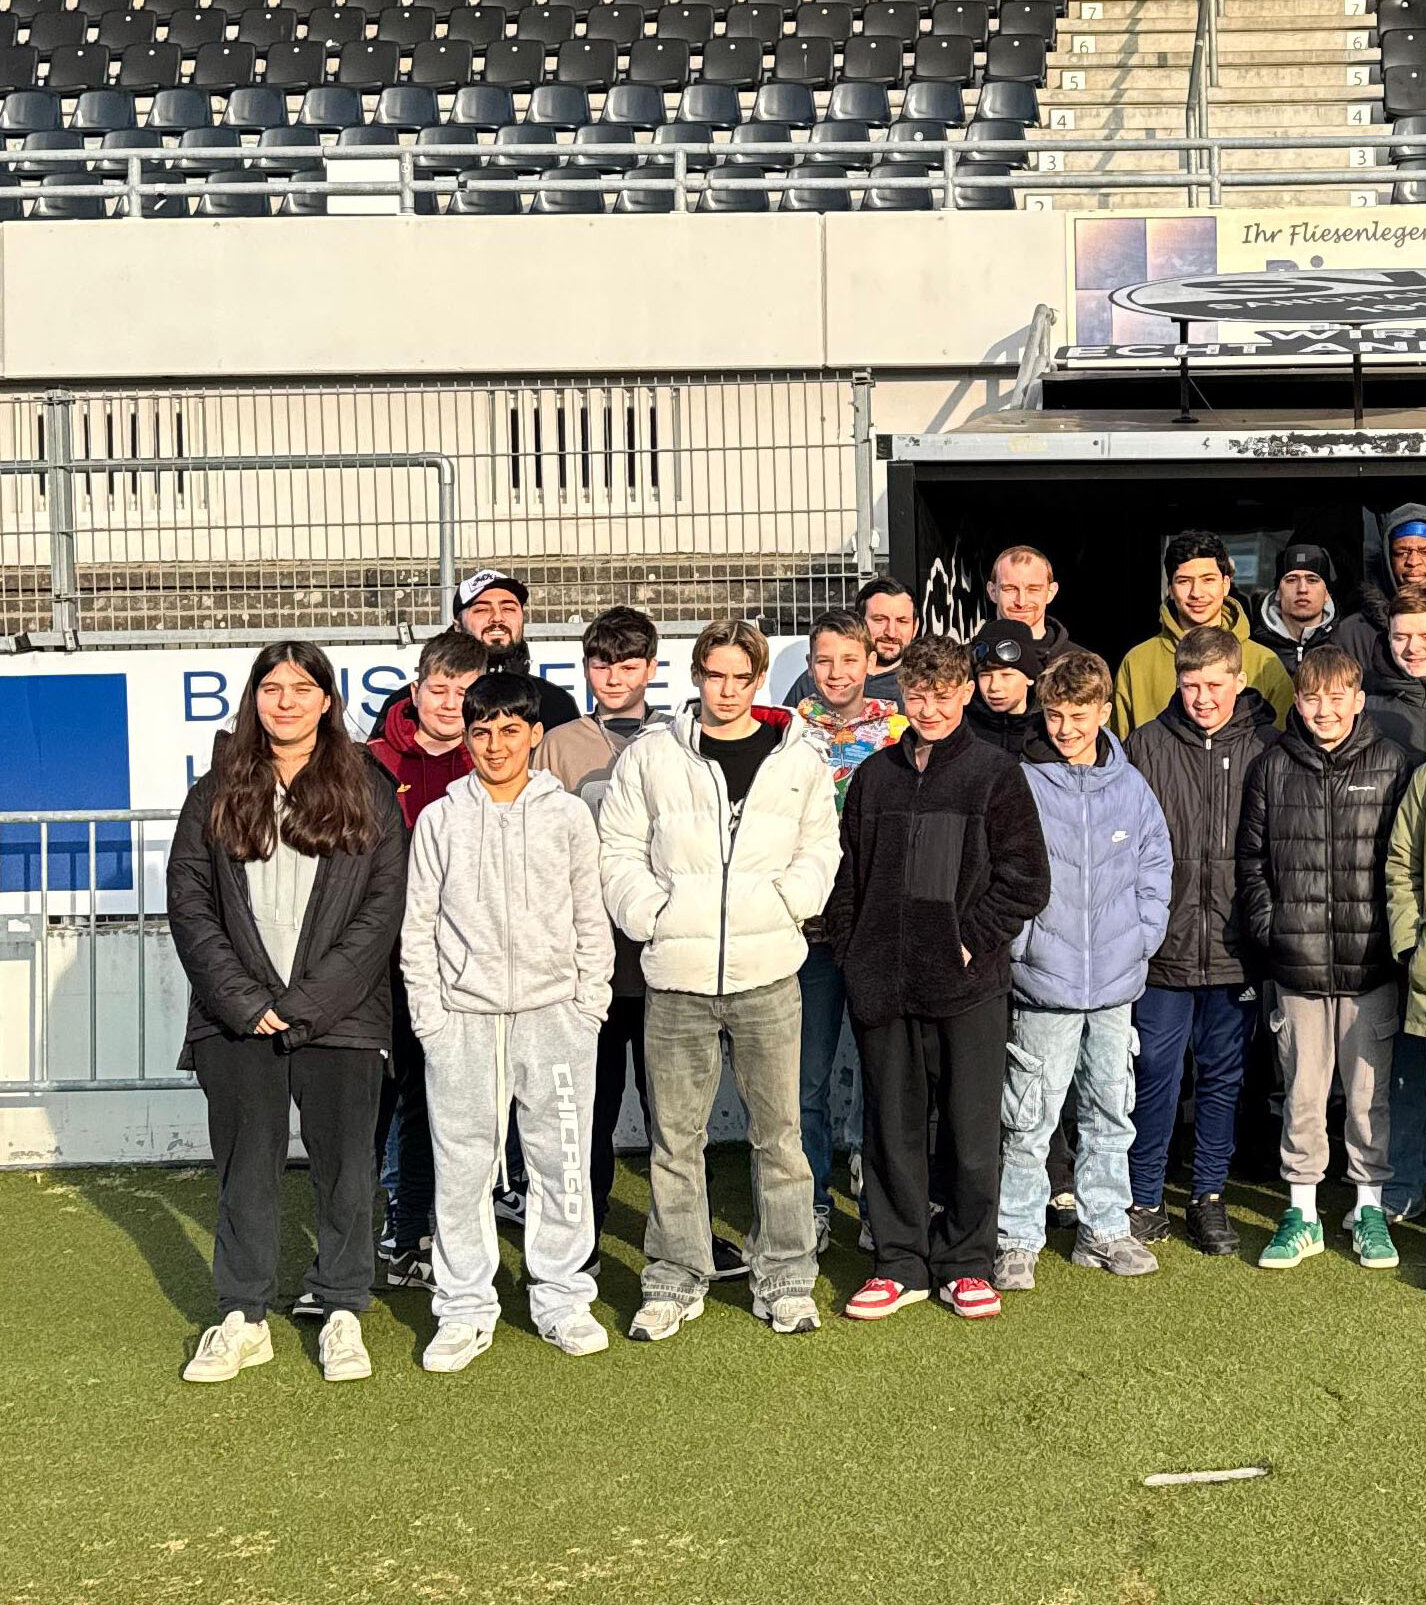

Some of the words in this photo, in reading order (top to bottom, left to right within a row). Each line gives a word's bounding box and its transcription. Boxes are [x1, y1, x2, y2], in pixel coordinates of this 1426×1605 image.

[1087, 6, 1097, 20] 7
[1079, 40, 1089, 54] 6
[1352, 36, 1363, 50] 6
[1069, 75, 1079, 90] 5
[1354, 71, 1363, 86] 5
[1056, 114, 1067, 129] 4
[1352, 109, 1363, 125] 4
[1046, 154, 1057, 171] 3
[1357, 149, 1367, 166] 3
[1241, 223, 1283, 245] Ihr
[1065, 343, 1272, 359] ECHT
[551, 1062, 583, 1223] CHICAGO
